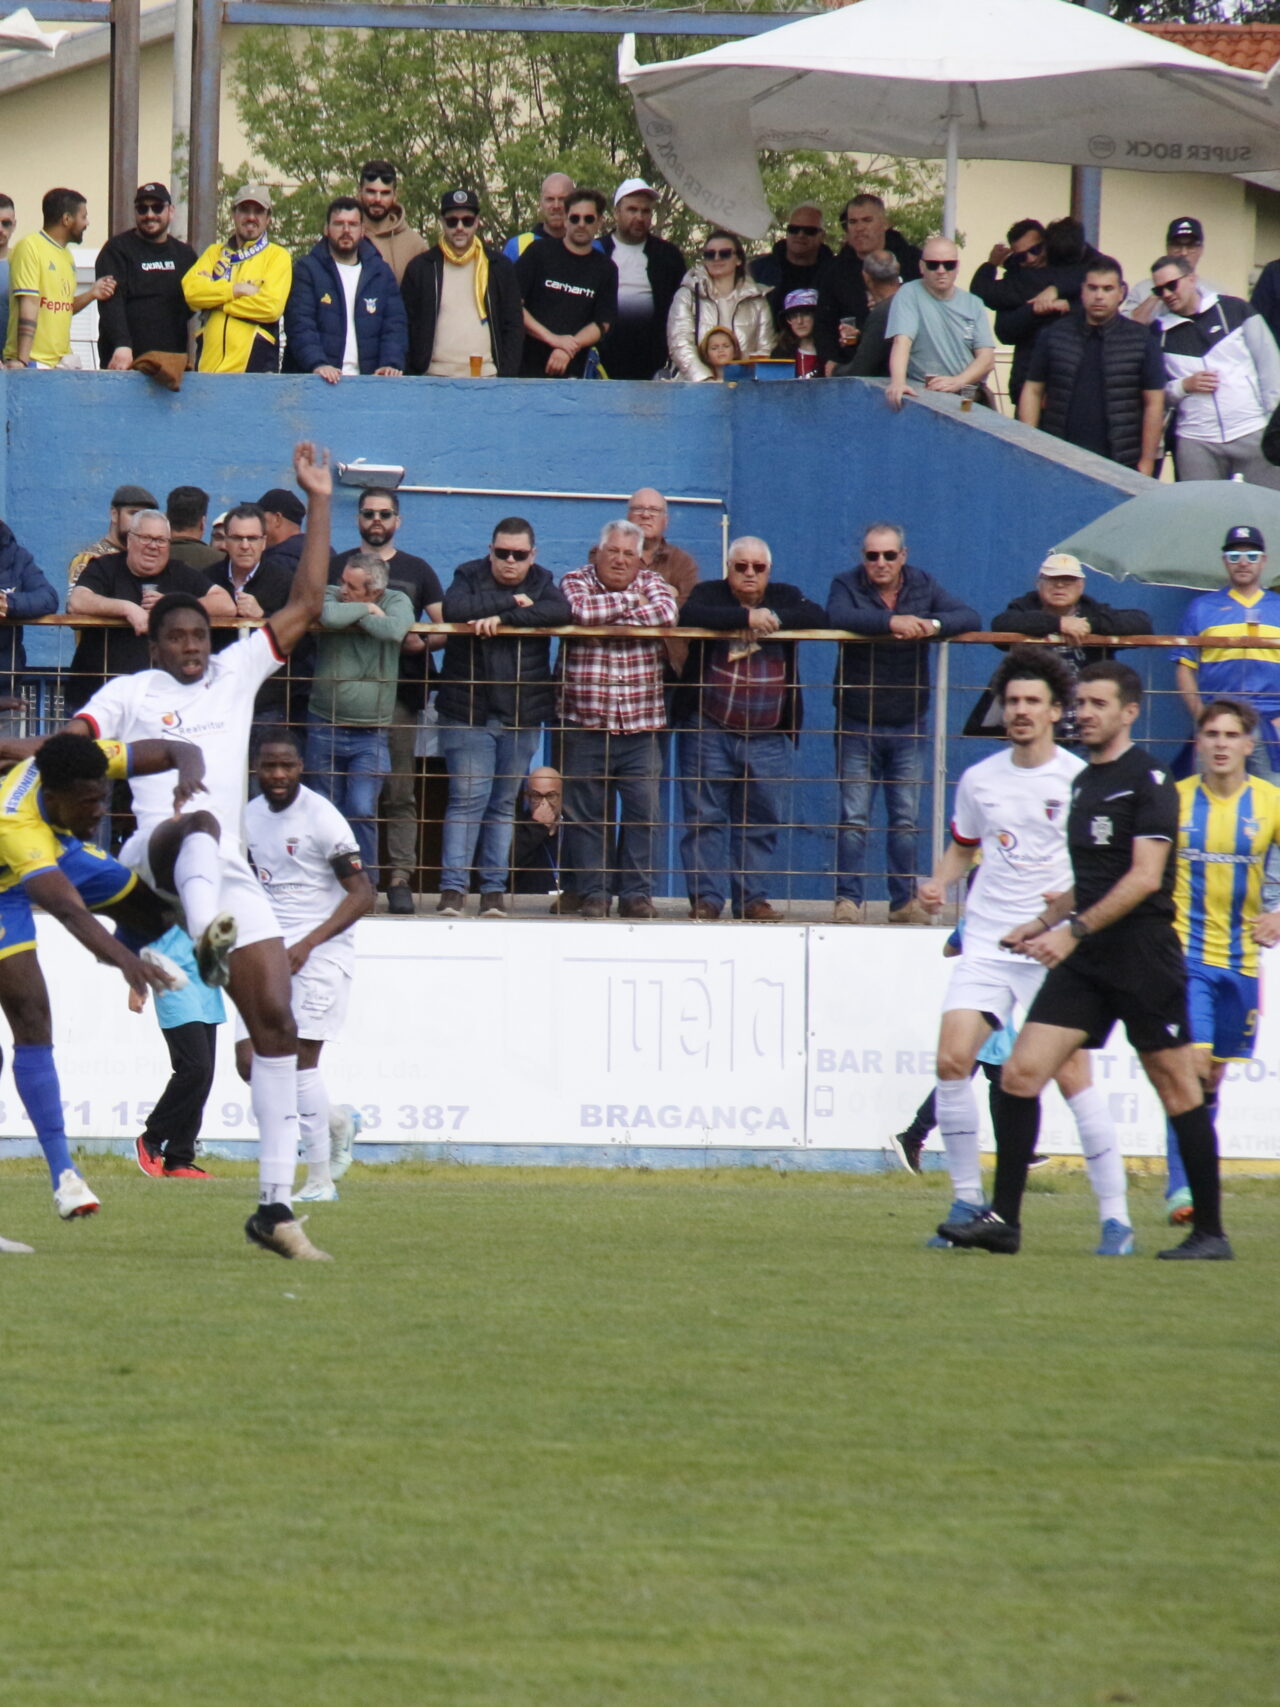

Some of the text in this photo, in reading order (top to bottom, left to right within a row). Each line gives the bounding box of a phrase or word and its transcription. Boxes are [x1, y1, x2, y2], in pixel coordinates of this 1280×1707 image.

[544, 279, 595, 298] carhartt
[816, 1047, 884, 1074] BAR
[397, 1104, 470, 1131] 387
[579, 1104, 790, 1135] BRAGANÇA
